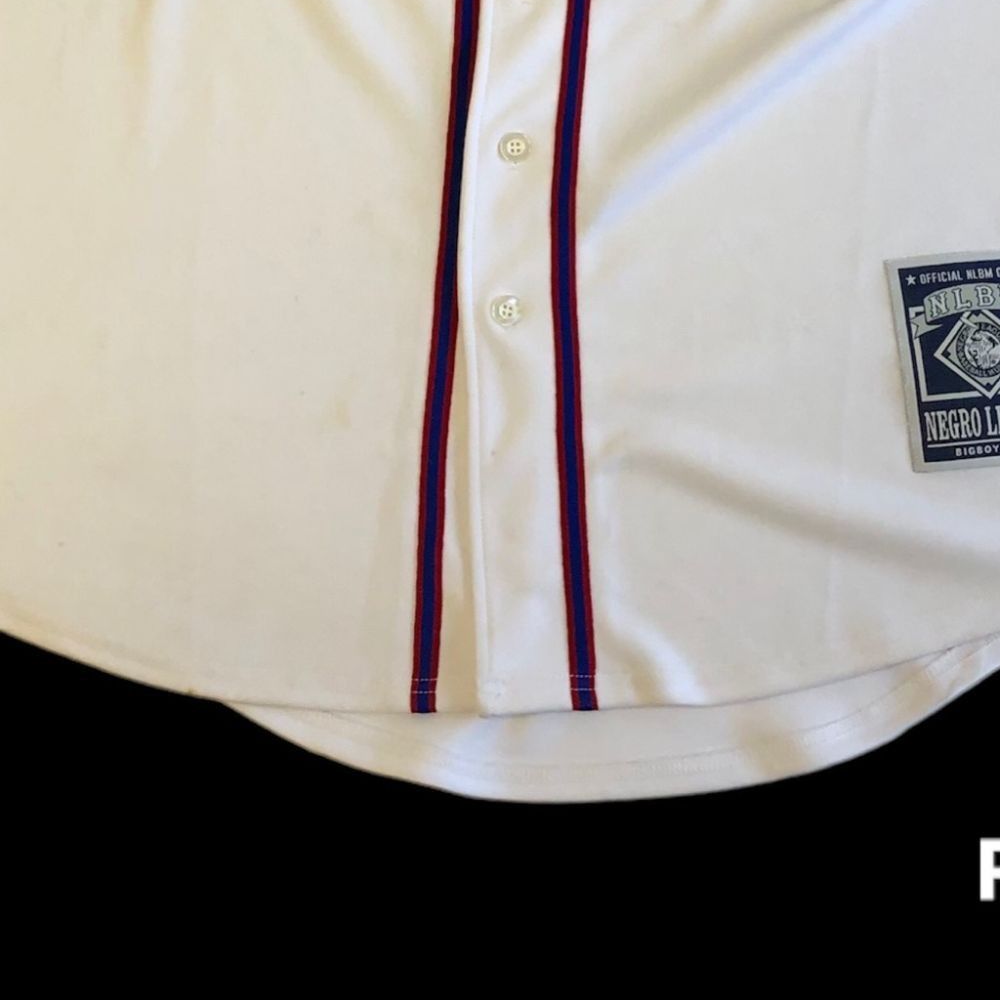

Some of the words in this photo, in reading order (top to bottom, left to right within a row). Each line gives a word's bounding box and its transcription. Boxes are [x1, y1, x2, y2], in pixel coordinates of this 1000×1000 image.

[919, 270, 962, 284] OFFICIAL
[966, 267, 994, 281] NLBM
[924, 404, 982, 442] NEGRO
[955, 444, 1000, 457] BIGBOY
